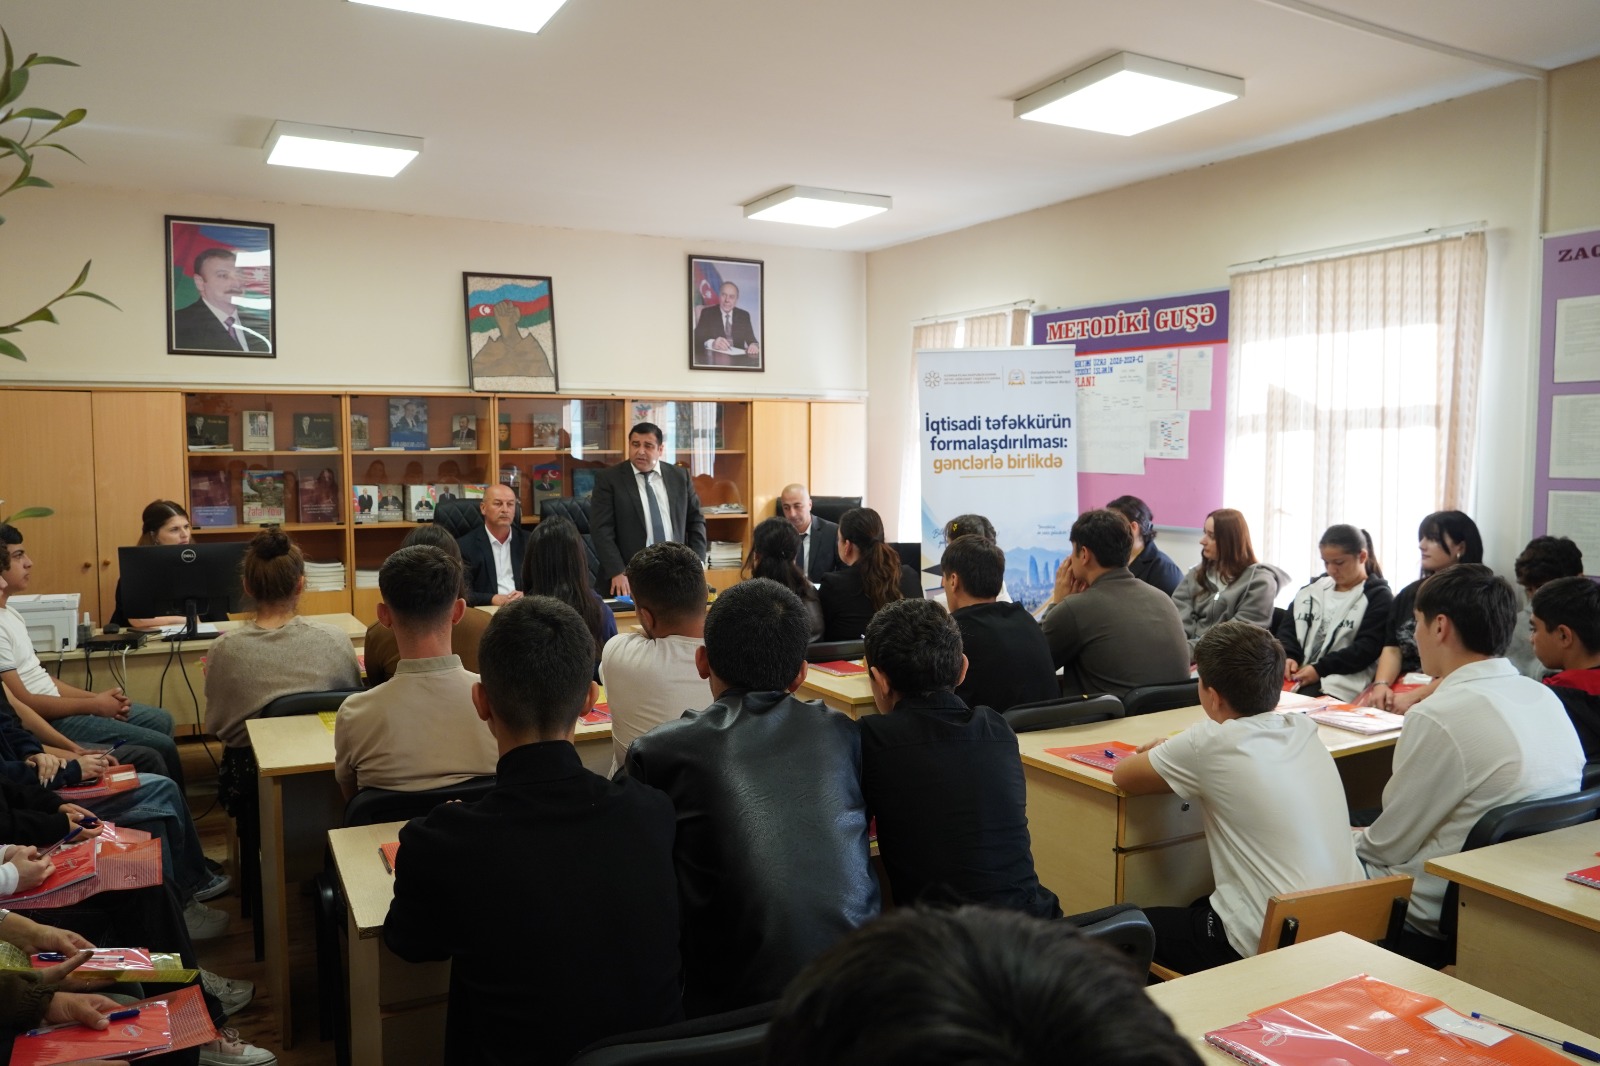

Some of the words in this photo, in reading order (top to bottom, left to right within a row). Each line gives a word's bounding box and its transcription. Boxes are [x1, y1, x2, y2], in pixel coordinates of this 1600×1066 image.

[1047, 308, 1150, 342] METODİKİ
[1154, 303, 1216, 332] GUŞƏ
[925, 412, 981, 435] İqtisadi
[985, 414, 1071, 431] təfəkkürün
[930, 434, 1068, 453] formalaşdırılması:
[933, 454, 1004, 474] gənclərlə
[1007, 453, 1063, 469] birlikdə
